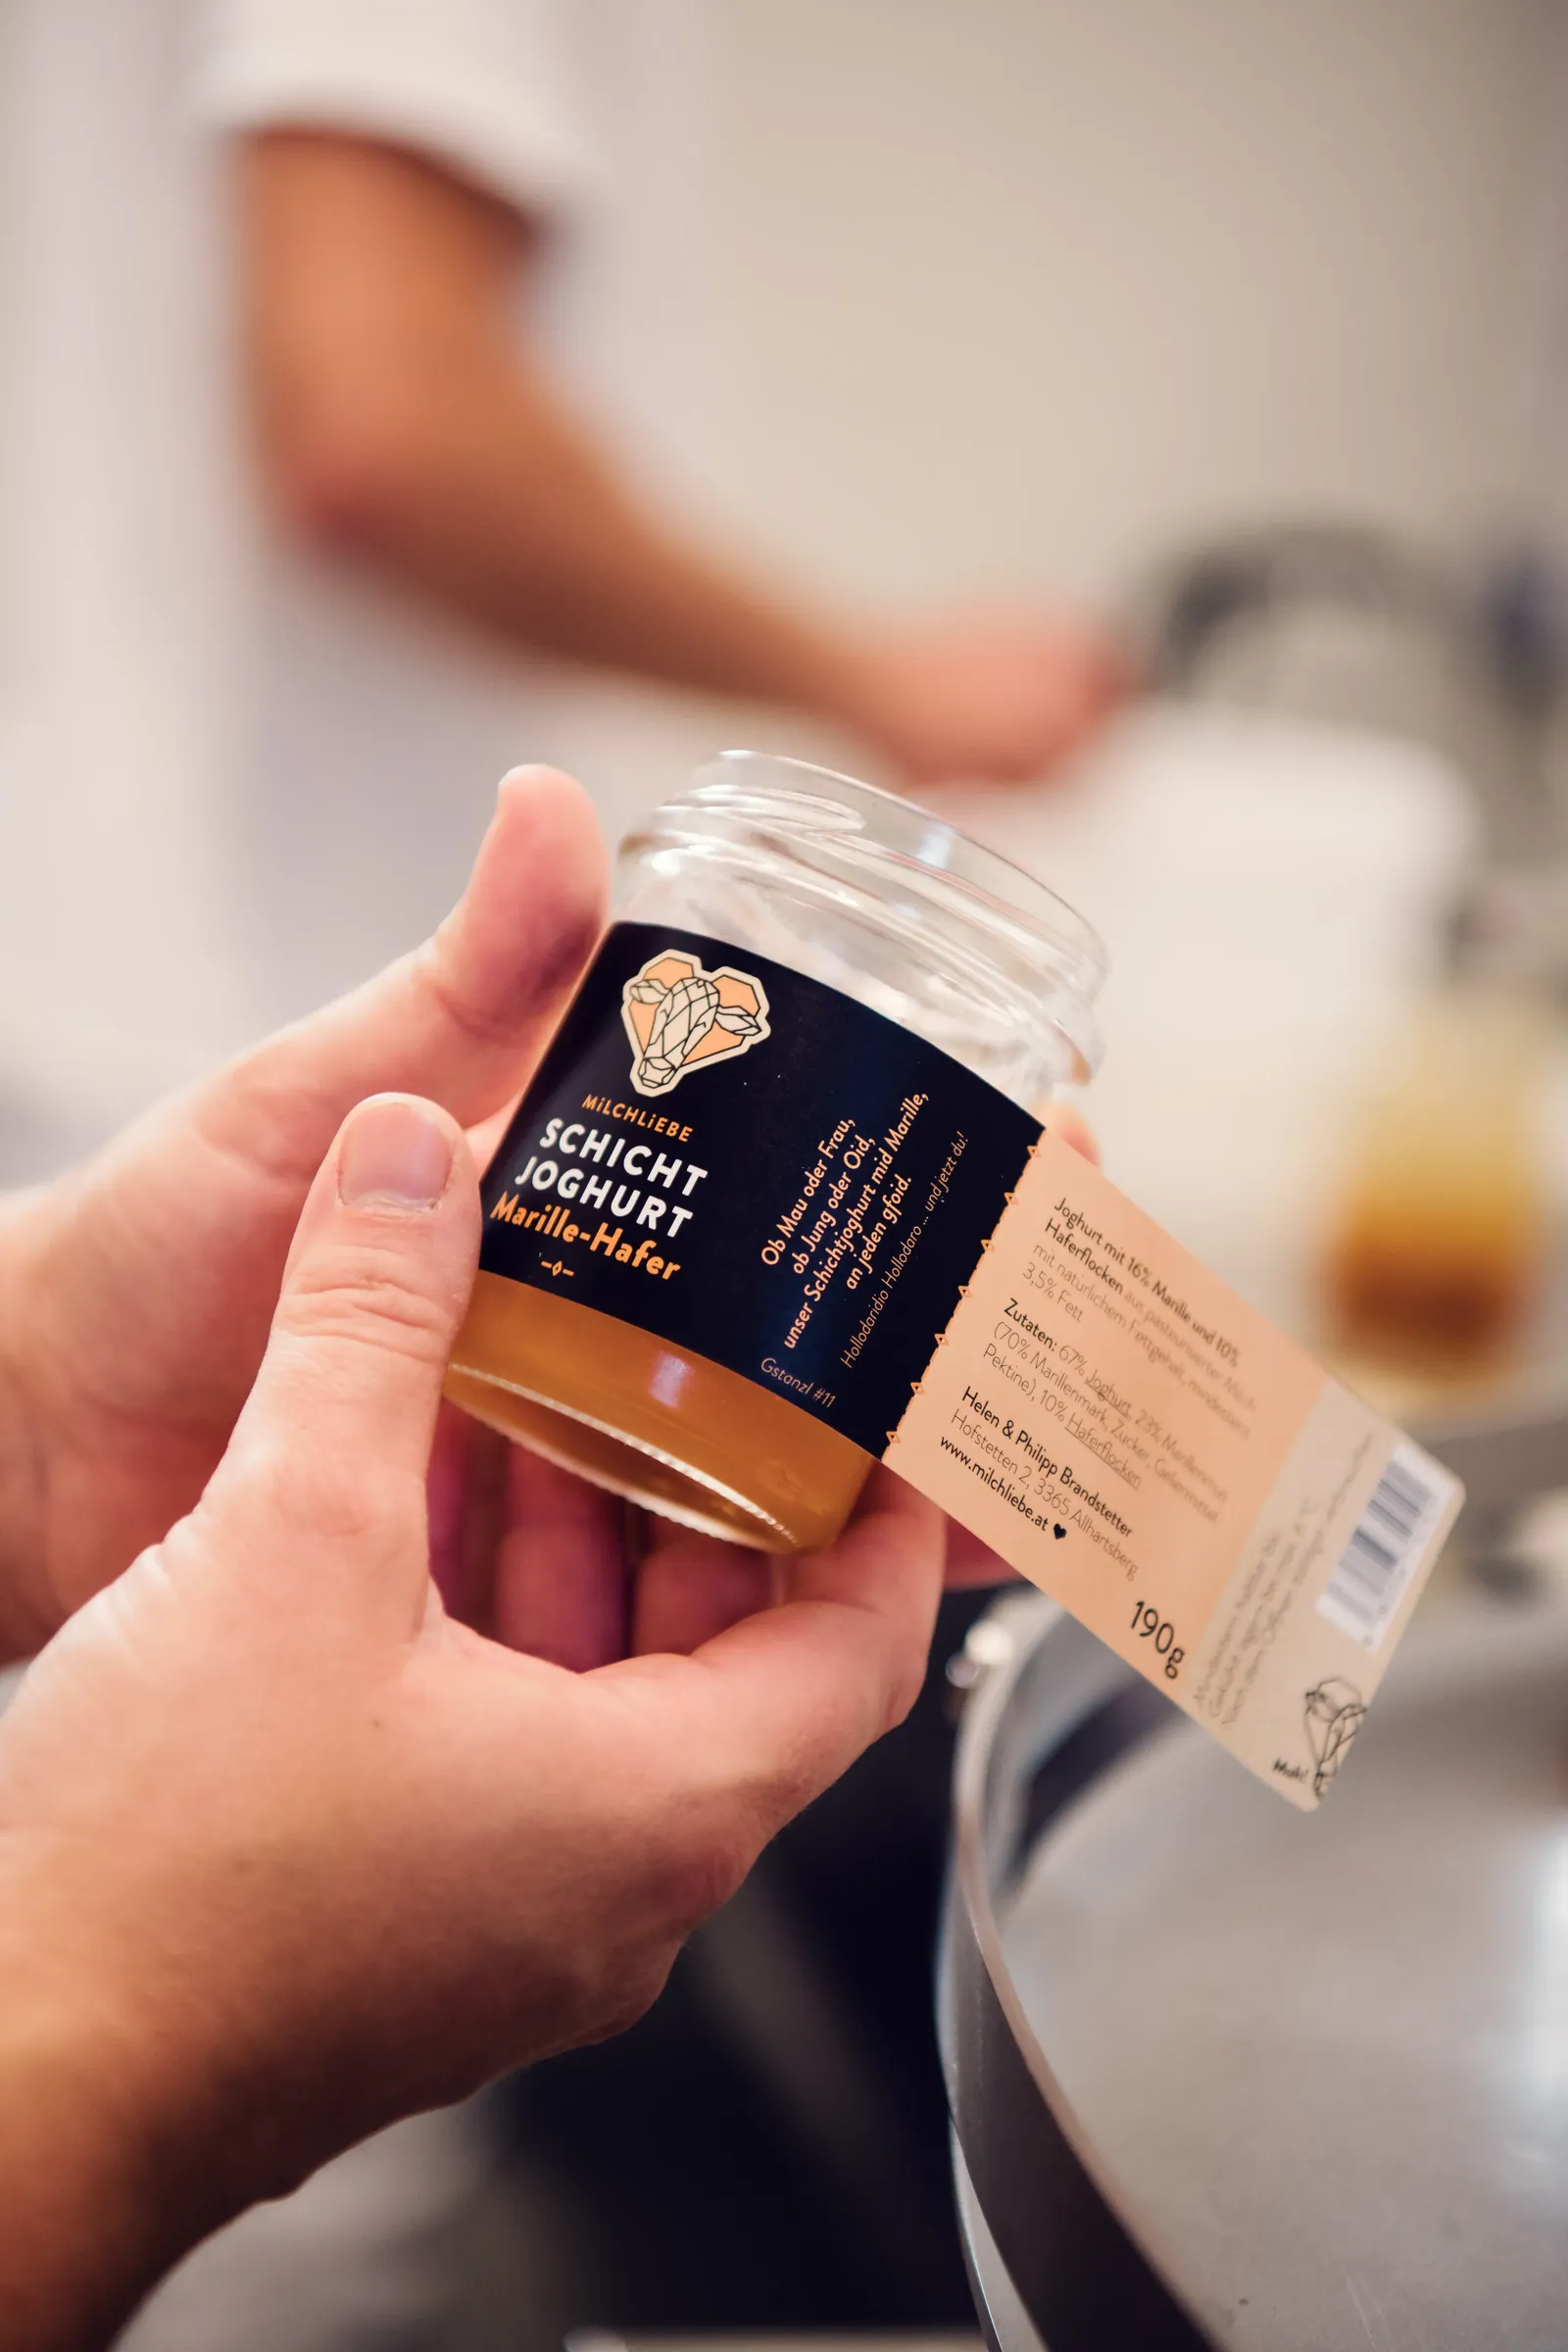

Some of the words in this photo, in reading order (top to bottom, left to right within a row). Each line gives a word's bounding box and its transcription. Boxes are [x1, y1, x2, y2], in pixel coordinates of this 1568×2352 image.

[513, 1154, 693, 1238] JOGHURT
[538, 1116, 708, 1196] SCHICHT
[760, 1239, 786, 1265] Ob
[775, 1198, 808, 1239] Mau
[803, 1158, 827, 1197] oder
[816, 1118, 856, 1159] Frau,
[881, 1172, 911, 1224] gfoid.
[488, 1189, 681, 1280] Marille-Hafer
[783, 1300, 812, 1348] unser
[803, 1183, 886, 1302] Schichtjoghurt
[870, 1147, 894, 1185] mid
[883, 1093, 929, 1152] Marille,
[791, 1251, 809, 1274] ob
[800, 1209, 837, 1252] Jung
[827, 1170, 852, 1209] oder
[842, 1133, 876, 1169] Oid,
[839, 1289, 889, 1368] Hollodaridio
[880, 1225, 922, 1289] Hollodaro
[924, 1181, 942, 1211] und
[933, 1155, 957, 1193] jetzt
[950, 1130, 968, 1156] du!
[850, 1221, 887, 1274] jeden
[846, 1266, 863, 1290] an
[1021, 1260, 1057, 1299] 3,5%
[1055, 1288, 1083, 1323] Fett
[1032, 1244, 1055, 1268] mit
[1044, 1216, 1123, 1295] Haferflocken
[1123, 1291, 1145, 1313] aus
[1053, 1196, 1103, 1246] Joghurt
[1102, 1241, 1126, 1265] mit
[1126, 1255, 1152, 1287] 16%
[1151, 1278, 1192, 1324] Marille
[1191, 1320, 1217, 1345] und
[1214, 1335, 1239, 1368] 10%
[760, 1356, 814, 1395] Gstanzl
[811, 1387, 836, 1407] #11
[1003, 1297, 1057, 1352] Zutaten:
[1057, 1344, 1088, 1376] 67%
[982, 1342, 1037, 1401] Pektine),
[1039, 1389, 1068, 1422] 10%
[1063, 1411, 1142, 1491] Haferflocken
[993, 1320, 1031, 1360] (70%
[1028, 1349, 1108, 1432] Marillenmark,
[1108, 1417, 1150, 1469] Zucker,
[940, 1435, 1049, 1532] www.milchliebe.at
[950, 1407, 1018, 1475] Hofstetten
[1017, 1464, 1032, 1491] 2,
[1032, 1476, 1071, 1516] 3365
[1069, 1509, 1139, 1582] Allhartsberg
[960, 1385, 1000, 1428] Helen
[1001, 1418, 1014, 1440] &
[1013, 1428, 1058, 1479] Philipp
[1058, 1465, 1133, 1538] Brandstetter
[1129, 1599, 1186, 1680] 190g
